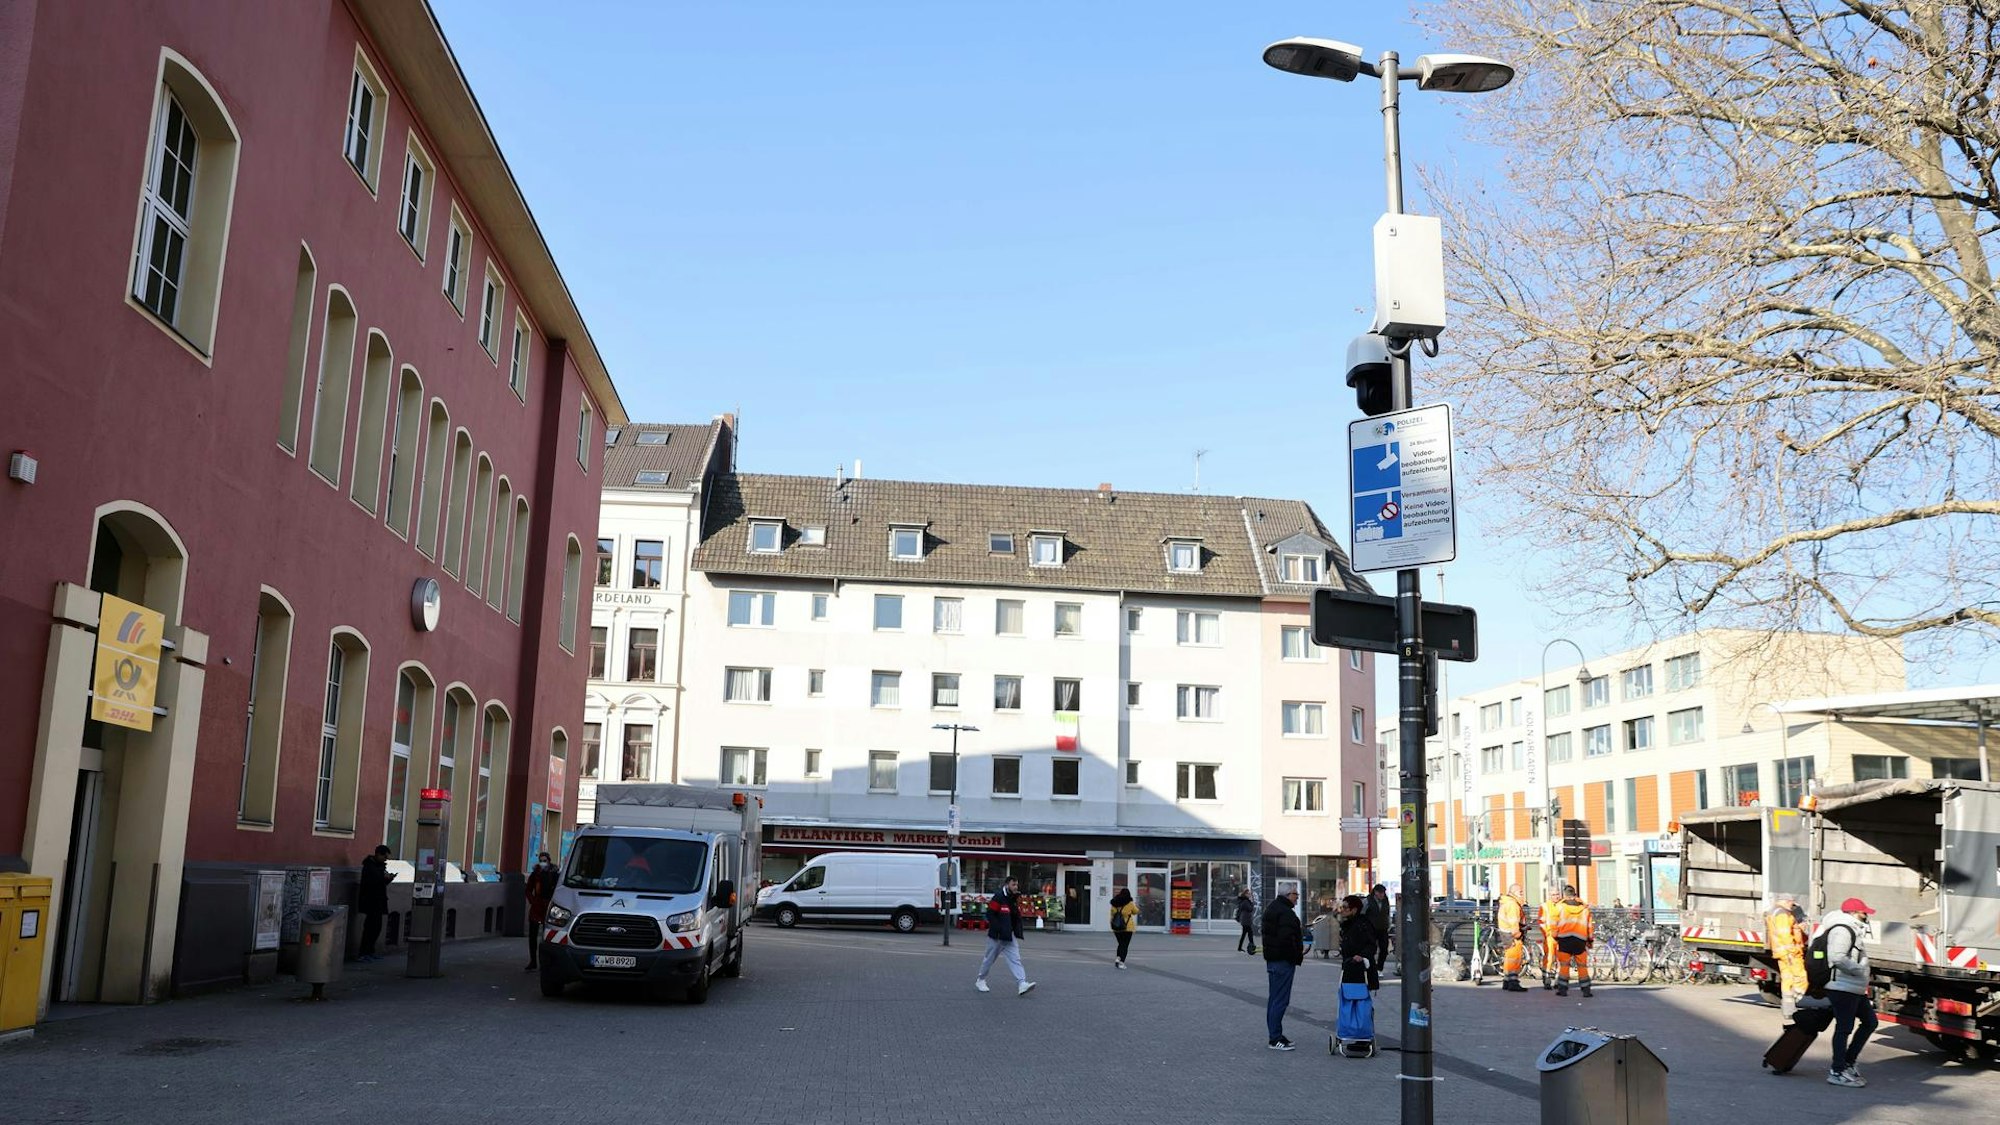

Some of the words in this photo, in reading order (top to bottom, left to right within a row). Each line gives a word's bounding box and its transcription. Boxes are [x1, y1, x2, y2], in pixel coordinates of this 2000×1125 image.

[1396, 416, 1423, 426] POLIZEI
[1412, 450, 1435, 458] Video-
[1401, 464, 1448, 477] aufzeichnung
[1404, 503, 1424, 511] Keine
[1403, 516, 1450, 528] aufzeichnung
[596, 593, 652, 604] RDELAND
[1405, 646, 1412, 657] 6
[779, 828, 885, 843] ATLANTIKER
[957, 835, 1002, 846] GmbH
[1648, 840, 1658, 851] U
